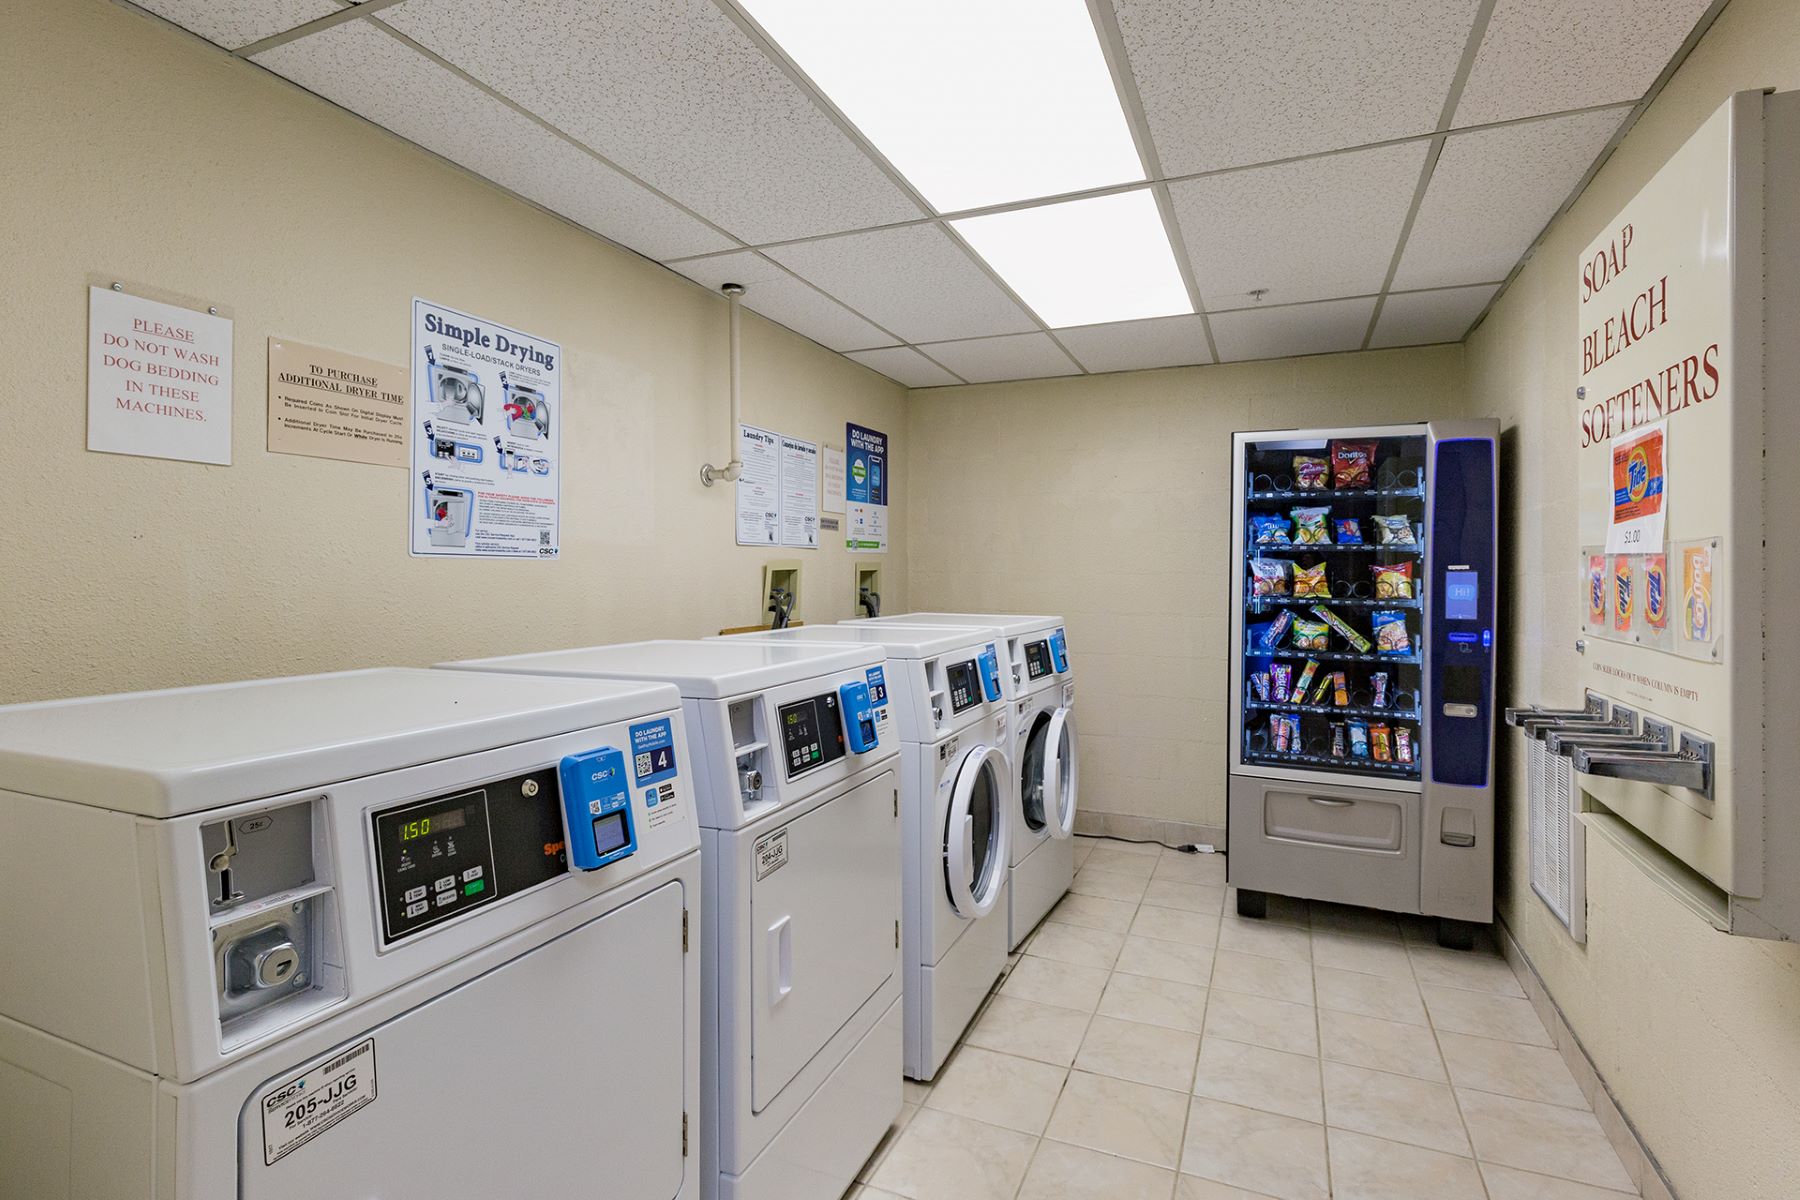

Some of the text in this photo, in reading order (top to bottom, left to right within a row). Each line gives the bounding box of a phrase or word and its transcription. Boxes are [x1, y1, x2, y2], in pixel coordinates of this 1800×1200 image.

[1583, 224, 1633, 304] SOAP
[133, 318, 194, 342] PLEASE
[1583, 275, 1668, 376] BLEACH
[103, 333, 219, 366] DO NOT WASH
[425, 313, 554, 371] Simple Drying
[104, 355, 218, 386] DOG BEDDING
[442, 344, 514, 370] SINGLE-LOAD/STACK
[515, 364, 541, 376] DRYERS
[310, 365, 378, 386] TO PURCHASE
[126, 380, 199, 402] IN THESE
[279, 373, 404, 403] ADDITIONAL DRYER TIME
[1582, 344, 1719, 449] SOFTENERS
[116, 397, 207, 422] MACHINES.
[285, 417, 311, 426] Additional
[744, 429, 774, 445] Laundry Tips
[851, 438, 884, 454] WITH THE APP
[852, 429, 882, 445] DO LAUNDRY
[1628, 460, 1647, 496] Tide
[1455, 587, 1470, 596] Hi!
[1592, 572, 1601, 608] Tide
[1616, 574, 1630, 614] Tide
[1648, 571, 1661, 615] Tide
[878, 686, 883, 698] 3
[1651, 679, 1672, 694] COLUMN
[1674, 686, 1679, 696] IS
[1680, 687, 1698, 702] EMPTY
[658, 751, 667, 767] 4
[592, 770, 608, 780] CSC
[403, 818, 430, 840] 1.50
[267, 1086, 296, 1108] CSC
[285, 1074, 357, 1128] 205-JJG
